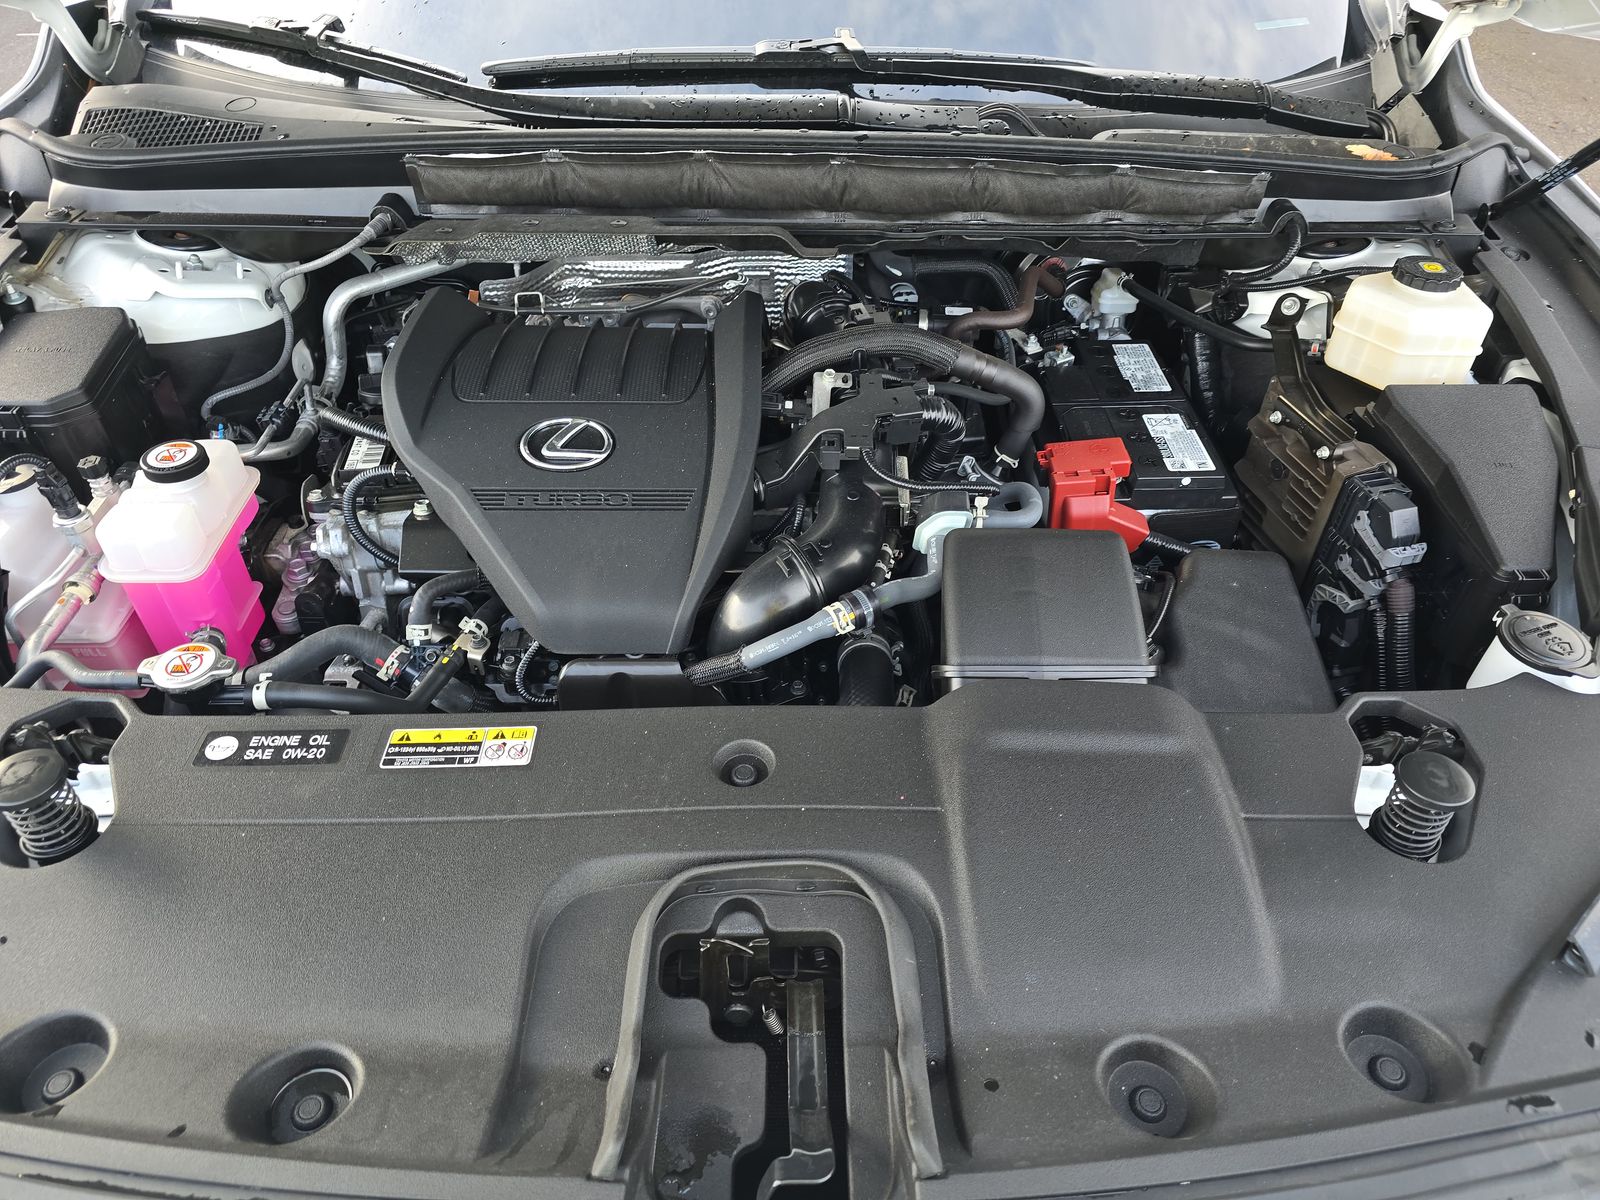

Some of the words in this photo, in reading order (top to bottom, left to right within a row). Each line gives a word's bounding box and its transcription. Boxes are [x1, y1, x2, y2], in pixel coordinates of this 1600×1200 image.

[507, 492, 630, 507] TURBO
[249, 735, 301, 747] ENGINE
[308, 735, 331, 746] OIL
[243, 748, 274, 760] SAE
[282, 747, 326, 759] 0W-20
